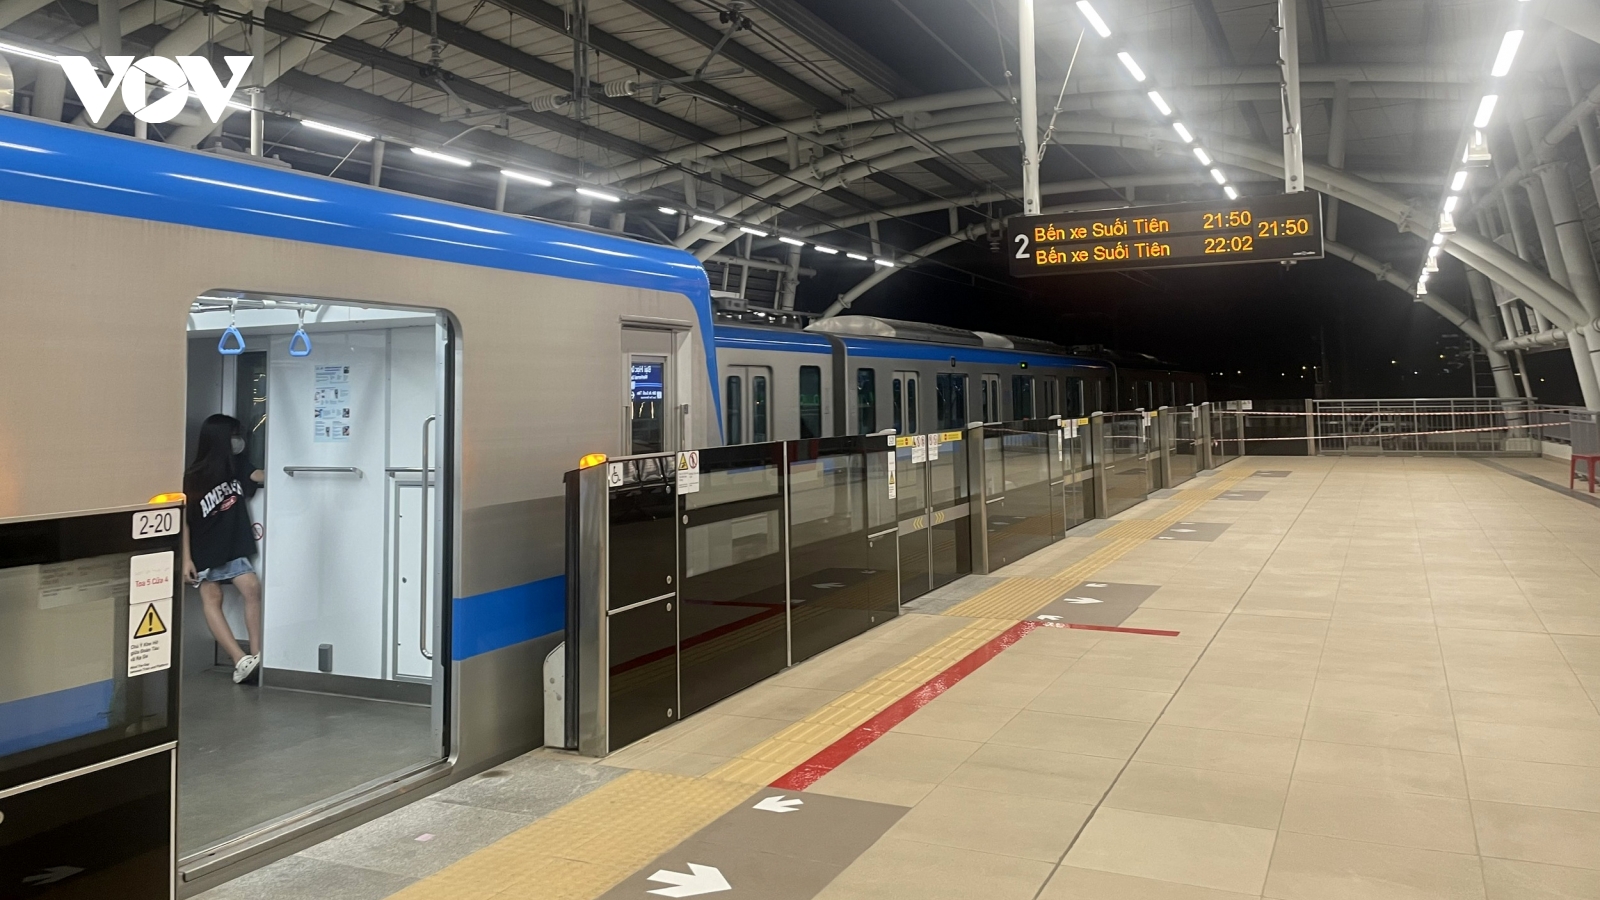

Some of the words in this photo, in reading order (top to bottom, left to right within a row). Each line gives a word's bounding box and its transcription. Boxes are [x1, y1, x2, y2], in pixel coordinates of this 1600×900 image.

[1034, 223, 1066, 242] Bến
[1070, 227, 1088, 240] xe
[1092, 218, 1128, 238] Suối
[1133, 218, 1169, 234] Tiên
[1202, 210, 1252, 229] 21:50
[1258, 218, 1309, 237] 21:50
[1014, 234, 1030, 259] 2
[1036, 246, 1067, 265] Bến
[1071, 250, 1089, 262] xe
[1093, 242, 1129, 261] Suối
[1134, 243, 1171, 258] Tiên
[1204, 235, 1253, 254] 22:02
[140, 512, 172, 535] 2-20
